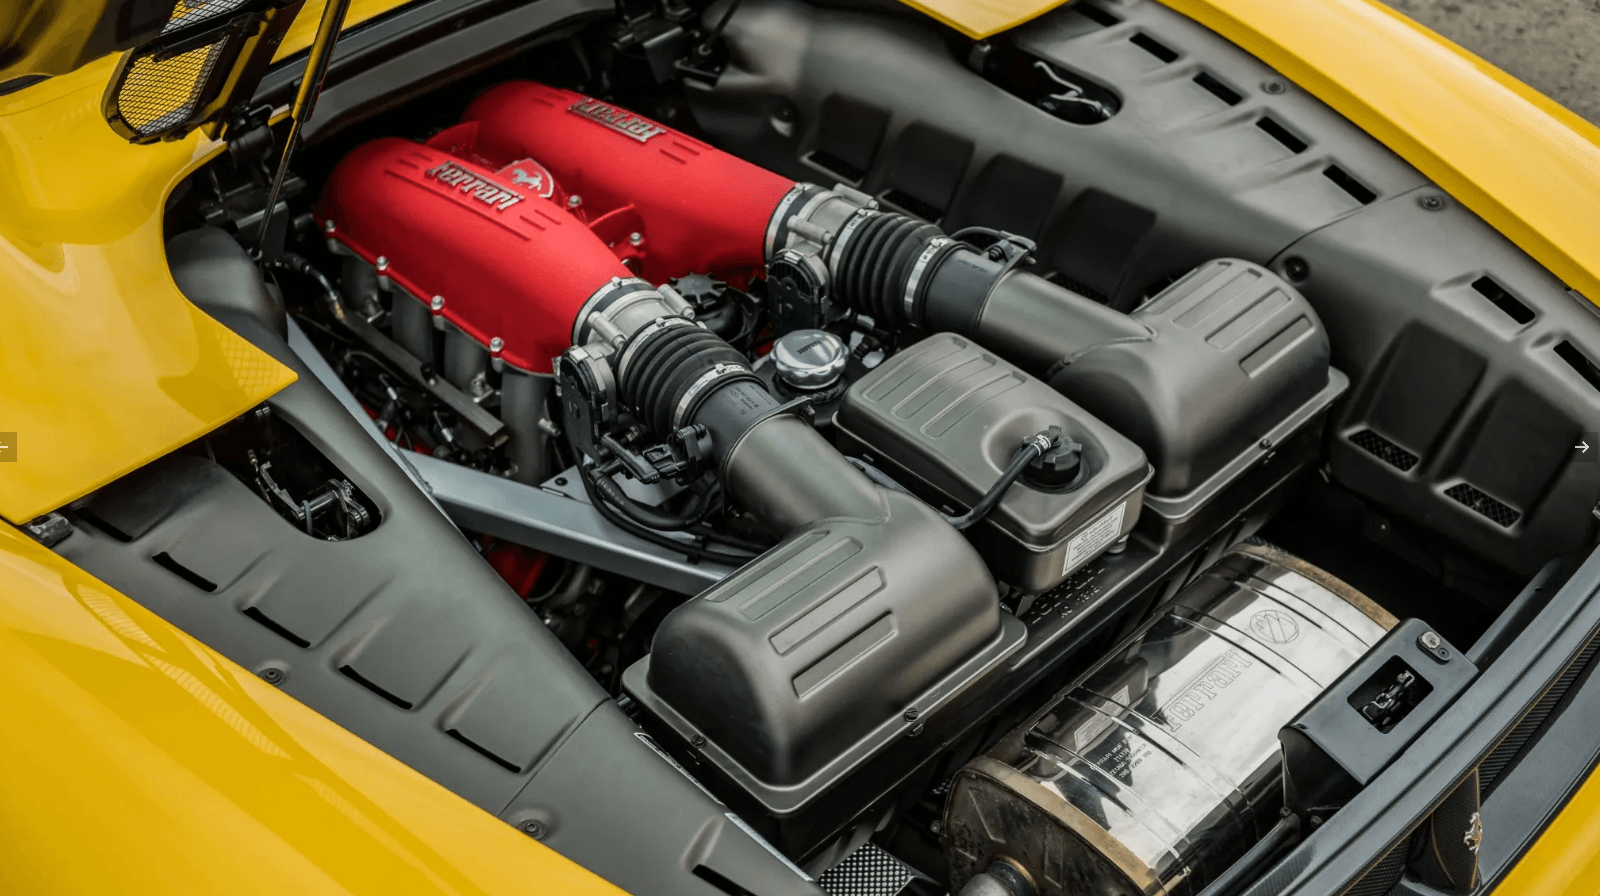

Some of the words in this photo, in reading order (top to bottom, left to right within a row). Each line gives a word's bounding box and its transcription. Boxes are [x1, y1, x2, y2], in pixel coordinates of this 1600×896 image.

[566, 97, 667, 143] Ferrari
[425, 160, 525, 211] Ferrari
[1149, 648, 1252, 733] Ferrari
